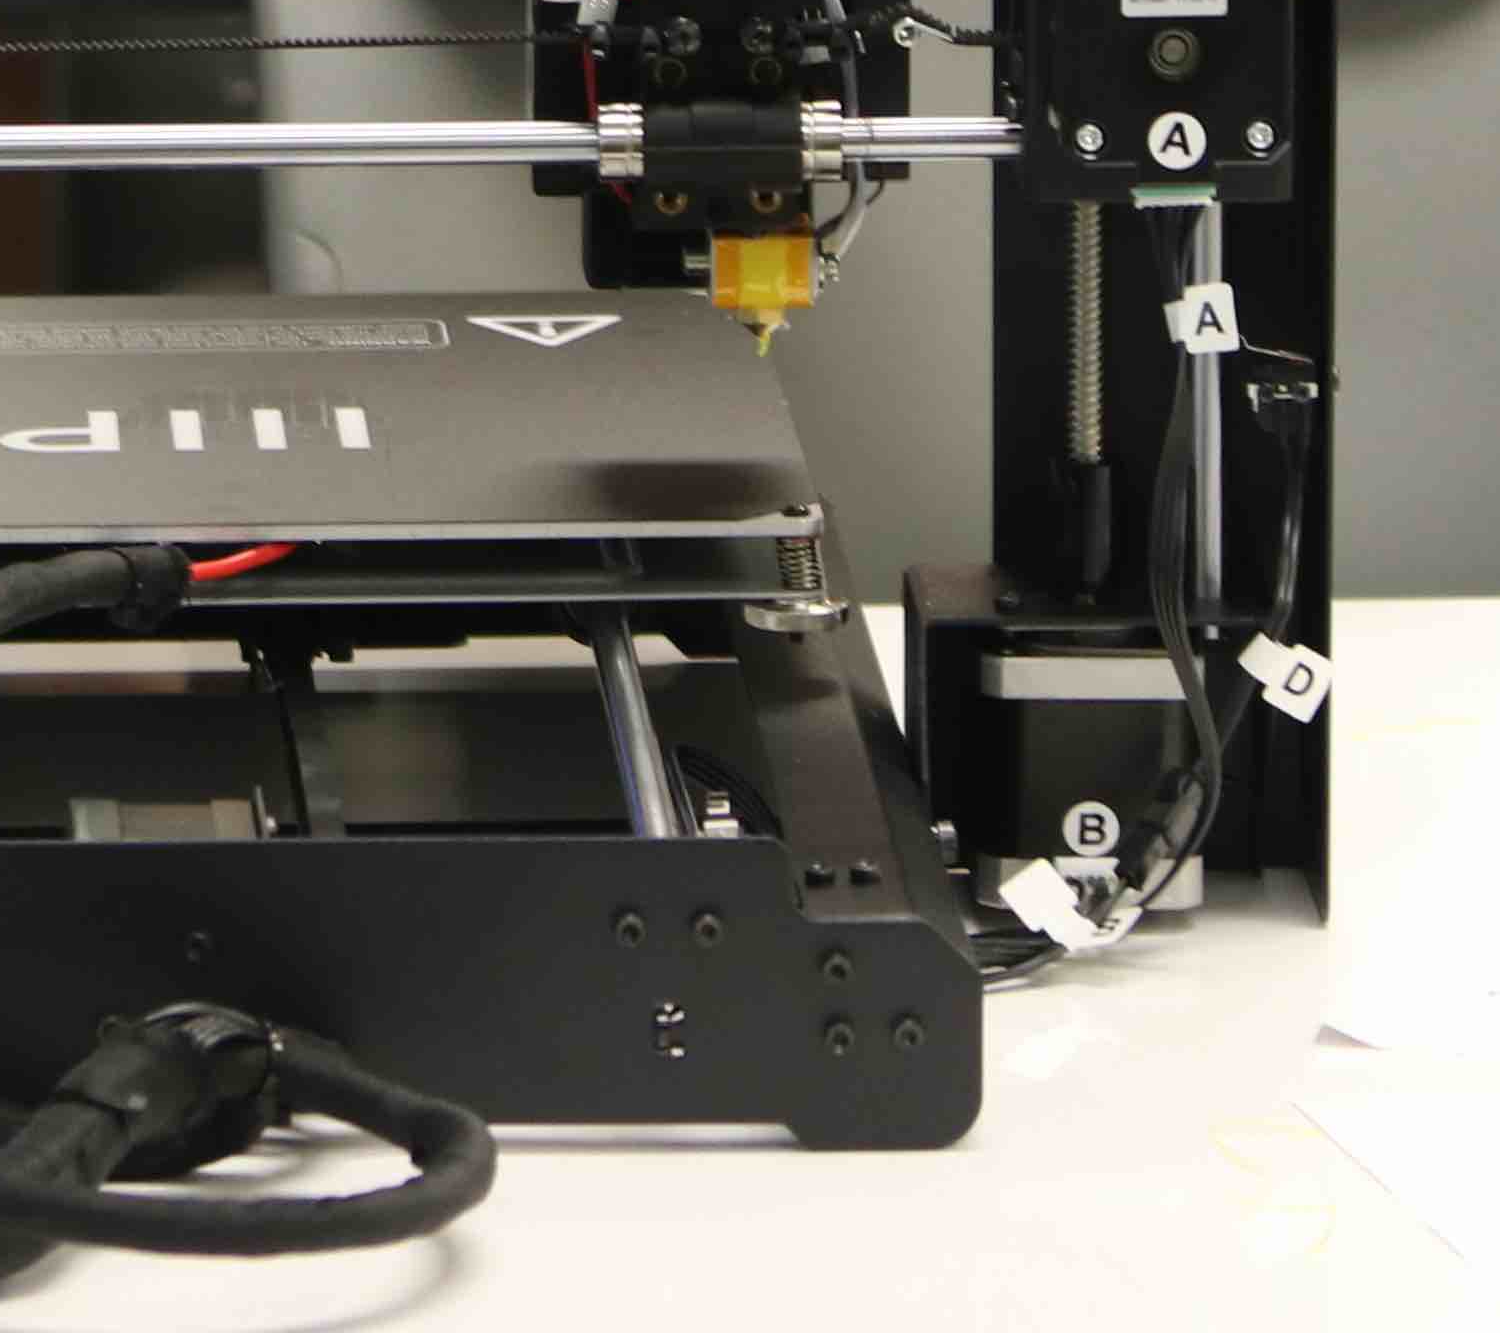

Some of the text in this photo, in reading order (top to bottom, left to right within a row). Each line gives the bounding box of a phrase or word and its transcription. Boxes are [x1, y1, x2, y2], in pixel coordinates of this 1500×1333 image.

[1160, 120, 1192, 157] A
[1194, 299, 1226, 337] A
[1282, 661, 1315, 697] D
[1078, 812, 1107, 846] B
